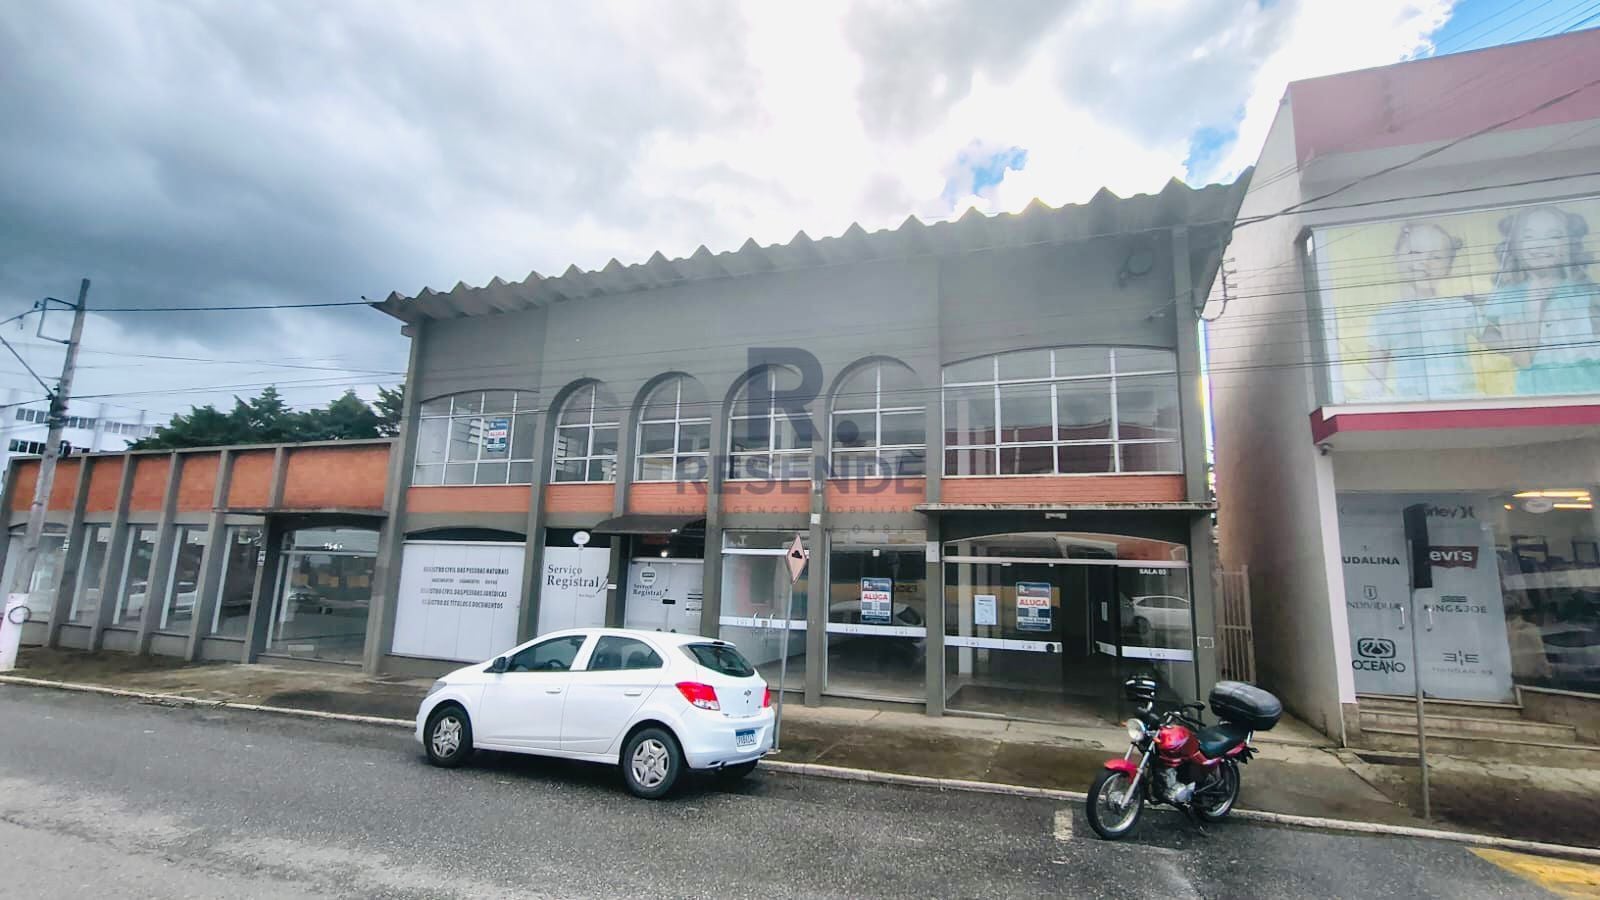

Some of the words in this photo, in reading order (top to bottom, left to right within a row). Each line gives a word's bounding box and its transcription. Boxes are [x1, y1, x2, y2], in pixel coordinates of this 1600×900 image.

[1342, 556, 1400, 565] UDALINA
[1429, 550, 1473, 562] evi's
[486, 568, 509, 576] NATURAIS
[548, 564, 582, 576] Serviço
[547, 575, 599, 591] Registral
[633, 589, 662, 598] Registral
[863, 593, 888, 601] ALUGA
[472, 601, 503, 609] DOCUMENTOS
[1019, 598, 1048, 607] ALUGA
[1424, 604, 1488, 614] NG&JOE
[1352, 660, 1406, 675] OCEANO
